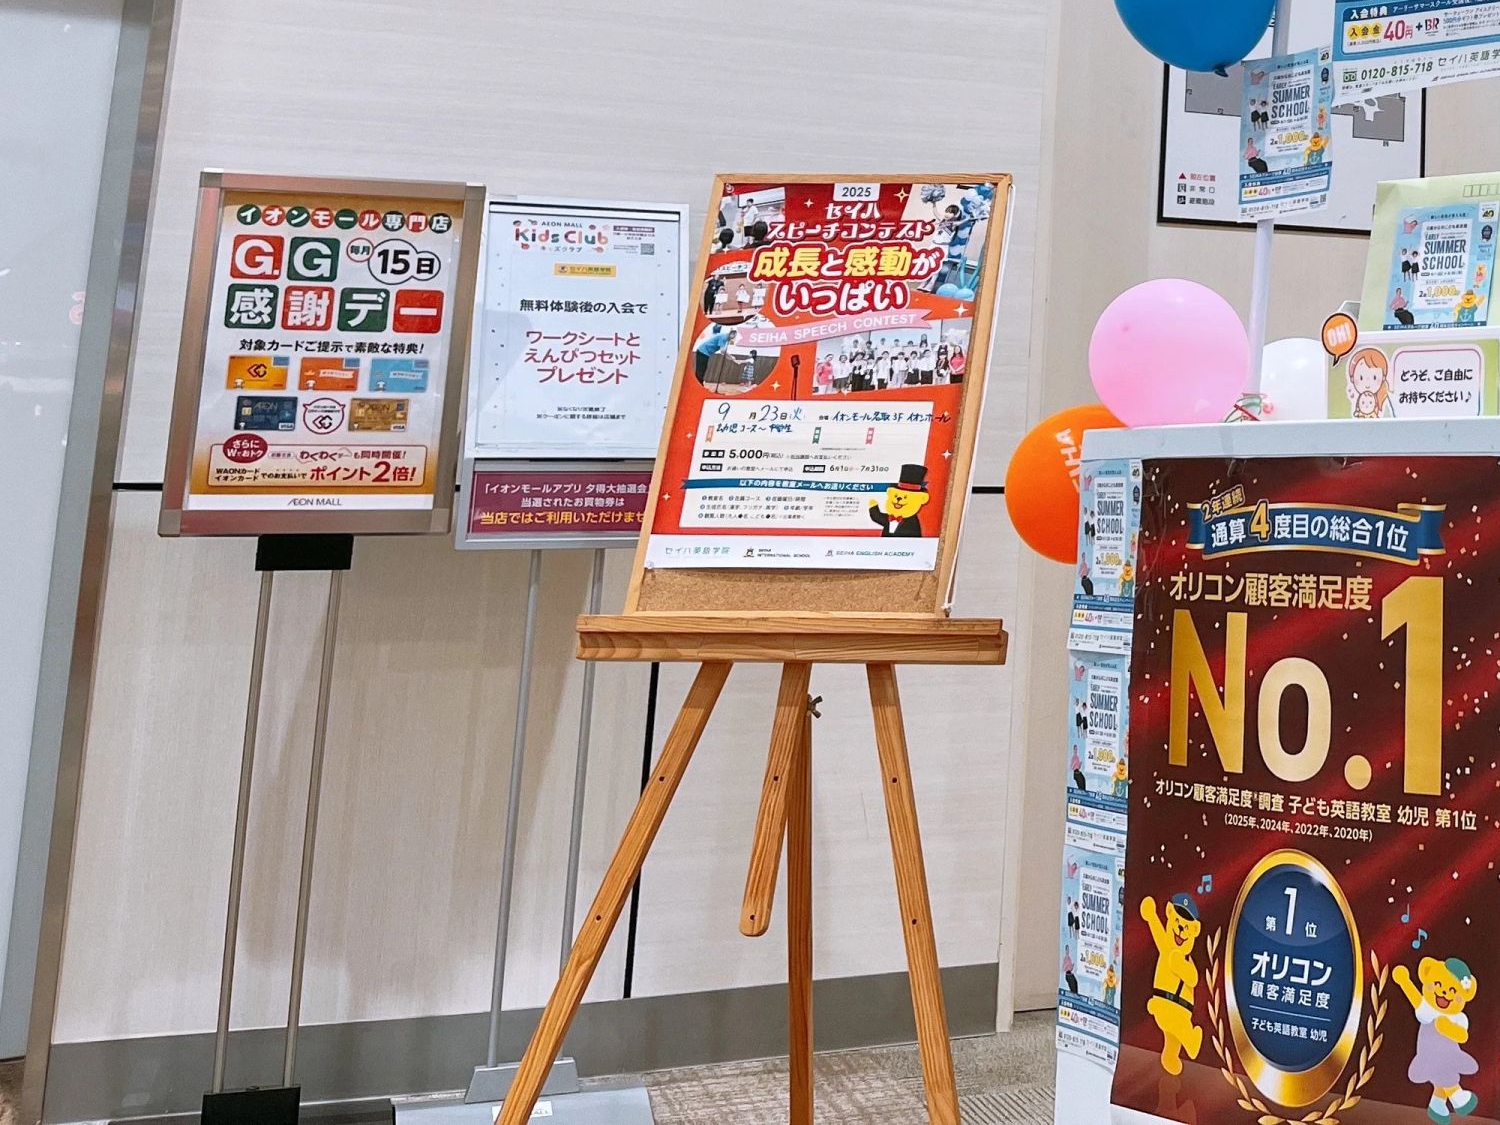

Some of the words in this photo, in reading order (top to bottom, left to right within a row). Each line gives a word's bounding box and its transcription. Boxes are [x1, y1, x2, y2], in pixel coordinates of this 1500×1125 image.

[1360, 61, 1433, 81] 0120-815-718
[1272, 85, 1310, 104] SUMMER
[1271, 101, 1309, 119] SCHOOL
[841, 186, 872, 197] 2025
[239, 206, 450, 232] イオンモール専門店
[825, 202, 880, 220] セイハ
[515, 228, 559, 243] Kids
[564, 230, 608, 245] Club
[766, 221, 935, 240] スピーチコンテスト
[1424, 239, 1466, 255] SUMMER
[377, 248, 434, 275] 15日
[754, 246, 939, 278] 成長と感動が
[1422, 255, 1464, 270] SCHOOL
[779, 281, 905, 313] いっぱい
[229, 288, 438, 327] 感謝デー
[520, 299, 648, 315] 無料体験後の入会で
[749, 331, 788, 343] SEIHA
[794, 322, 847, 340] SPEECH
[853, 313, 917, 330] CONTEST
[1327, 324, 1353, 346] OH!
[526, 331, 640, 347] ワークシートと
[524, 348, 640, 365] えんぴつセット
[537, 367, 629, 385] プレゼント
[1399, 367, 1474, 384] どうぞ、ご自由に
[232, 440, 260, 449] さらに
[214, 474, 259, 482] イオンカード
[484, 483, 581, 494] 「イオンモールアプリ
[315, 498, 342, 506] MALL
[521, 497, 624, 508] 当選されたお買物券は
[1096, 499, 1124, 516] SUMMER
[1096, 517, 1124, 534] SCHOOL
[1211, 500, 1409, 552] 通算4度目の総合1位
[1169, 571, 1373, 612] オリコン顧客満足度
[1168, 576, 1444, 796] No.1
[1089, 693, 1118, 712] SUMMER
[1089, 709, 1118, 731] SCHOOL
[1288, 795, 1392, 823] 子ども英語教室
[1397, 804, 1429, 827] 幼児
[1434, 807, 1478, 831] 第1位
[1081, 891, 1110, 916] SUMMER
[1081, 911, 1109, 935] SCHOOL
[1250, 952, 1332, 987] オリコン
[1250, 980, 1331, 1010] 顧客満足度
[1251, 1017, 1308, 1040] 子ども英語教室
[1309, 1025, 1328, 1043] 幼児
